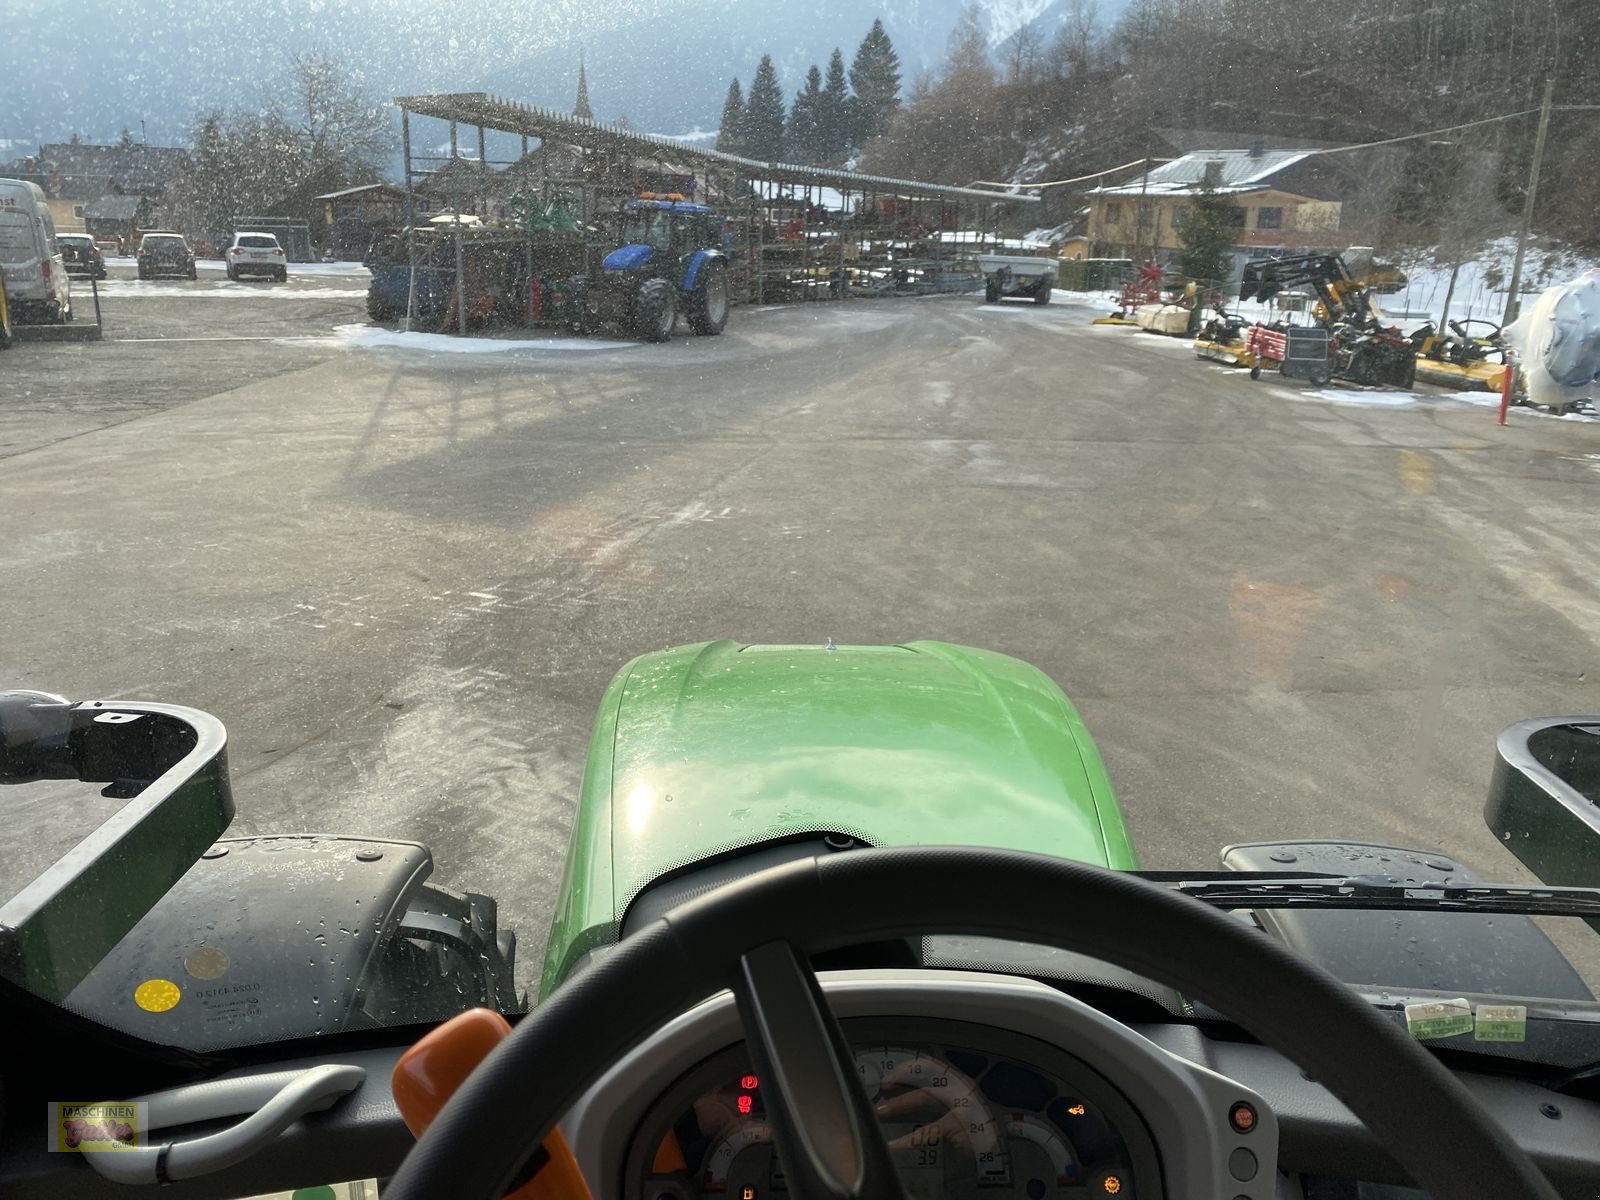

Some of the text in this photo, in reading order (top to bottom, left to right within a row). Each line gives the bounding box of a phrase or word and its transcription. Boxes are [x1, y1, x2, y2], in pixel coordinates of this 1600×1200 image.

[880, 1061, 894, 1071] 16
[909, 1064, 922, 1074] 18
[932, 1077, 948, 1087] 20
[953, 1098, 969, 1108] 22
[969, 1123, 985, 1134] 24
[979, 1152, 994, 1163] 26
